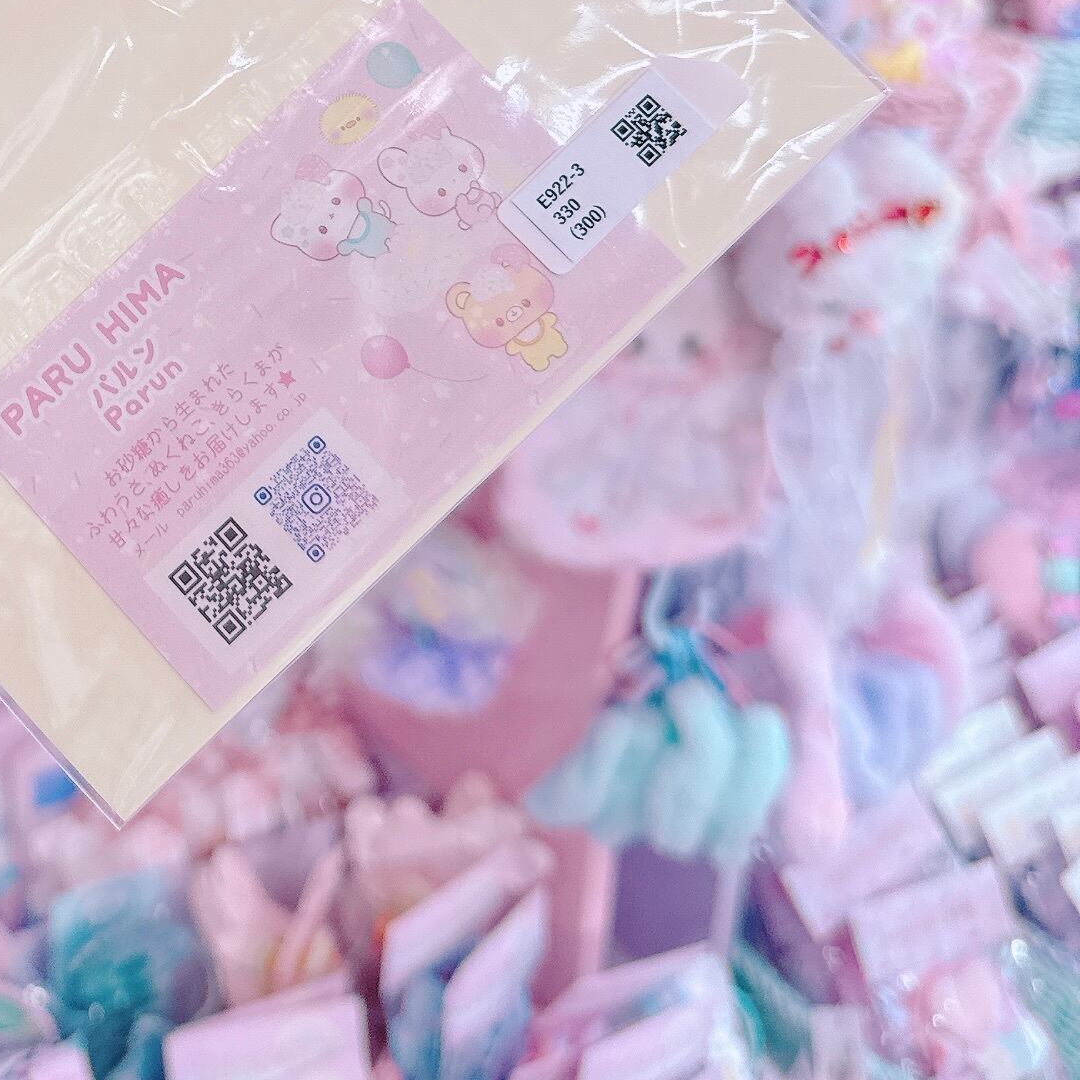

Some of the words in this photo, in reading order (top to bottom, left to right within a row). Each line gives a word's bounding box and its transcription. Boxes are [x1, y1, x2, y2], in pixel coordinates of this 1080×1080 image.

[534, 161, 586, 210] E922-3
[552, 196, 581, 226] 330
[569, 204, 608, 240] (300)
[0, 343, 91, 435] PARU
[95, 262, 185, 344] HIMA
[93, 338, 154, 408] パルン
[103, 360, 182, 431] Parun
[105, 363, 234, 487] お砂糖から生まれた
[136, 523, 168, 558] メール
